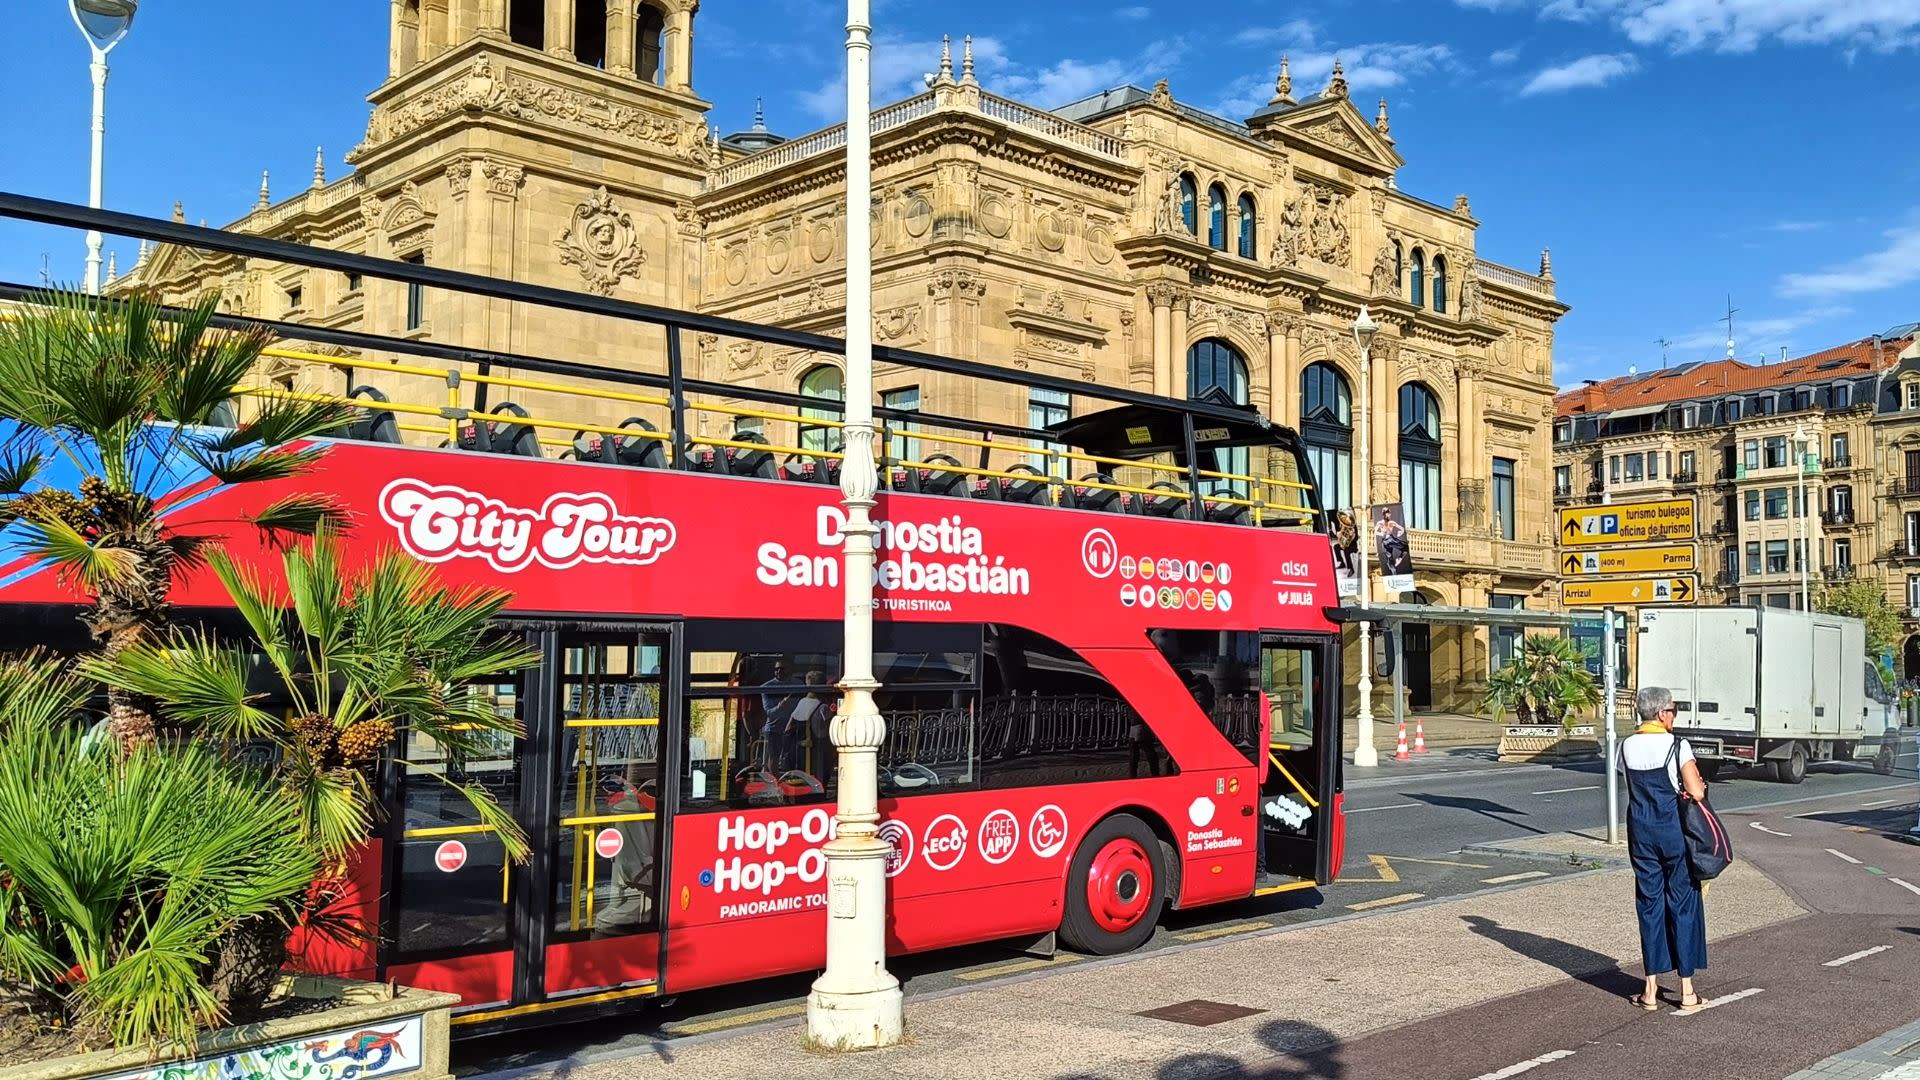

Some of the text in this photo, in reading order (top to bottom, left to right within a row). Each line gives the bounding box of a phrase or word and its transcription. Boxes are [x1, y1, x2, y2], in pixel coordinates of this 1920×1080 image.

[1626, 505, 1690, 520] turismo bulegoa
[391, 490, 667, 562] City Tour
[816, 505, 983, 555] Dnostia
[1603, 516, 1615, 533] P
[1619, 523, 1690, 537] oficina de turismo
[756, 542, 838, 588] San
[1663, 552, 1691, 563] Parma
[1281, 560, 1309, 577] alsa
[1565, 588, 1591, 598] Arrizul
[883, 598, 952, 612] TURISTIKOA
[986, 819, 1013, 837] FREE
[1187, 828, 1223, 842] Donostia
[930, 834, 962, 853] ECO
[985, 836, 1011, 855] APP
[1187, 836, 1243, 852] San Sebastián
[714, 848, 830, 896] Hop-O
[720, 892, 828, 919] PANORAMIC TOU
